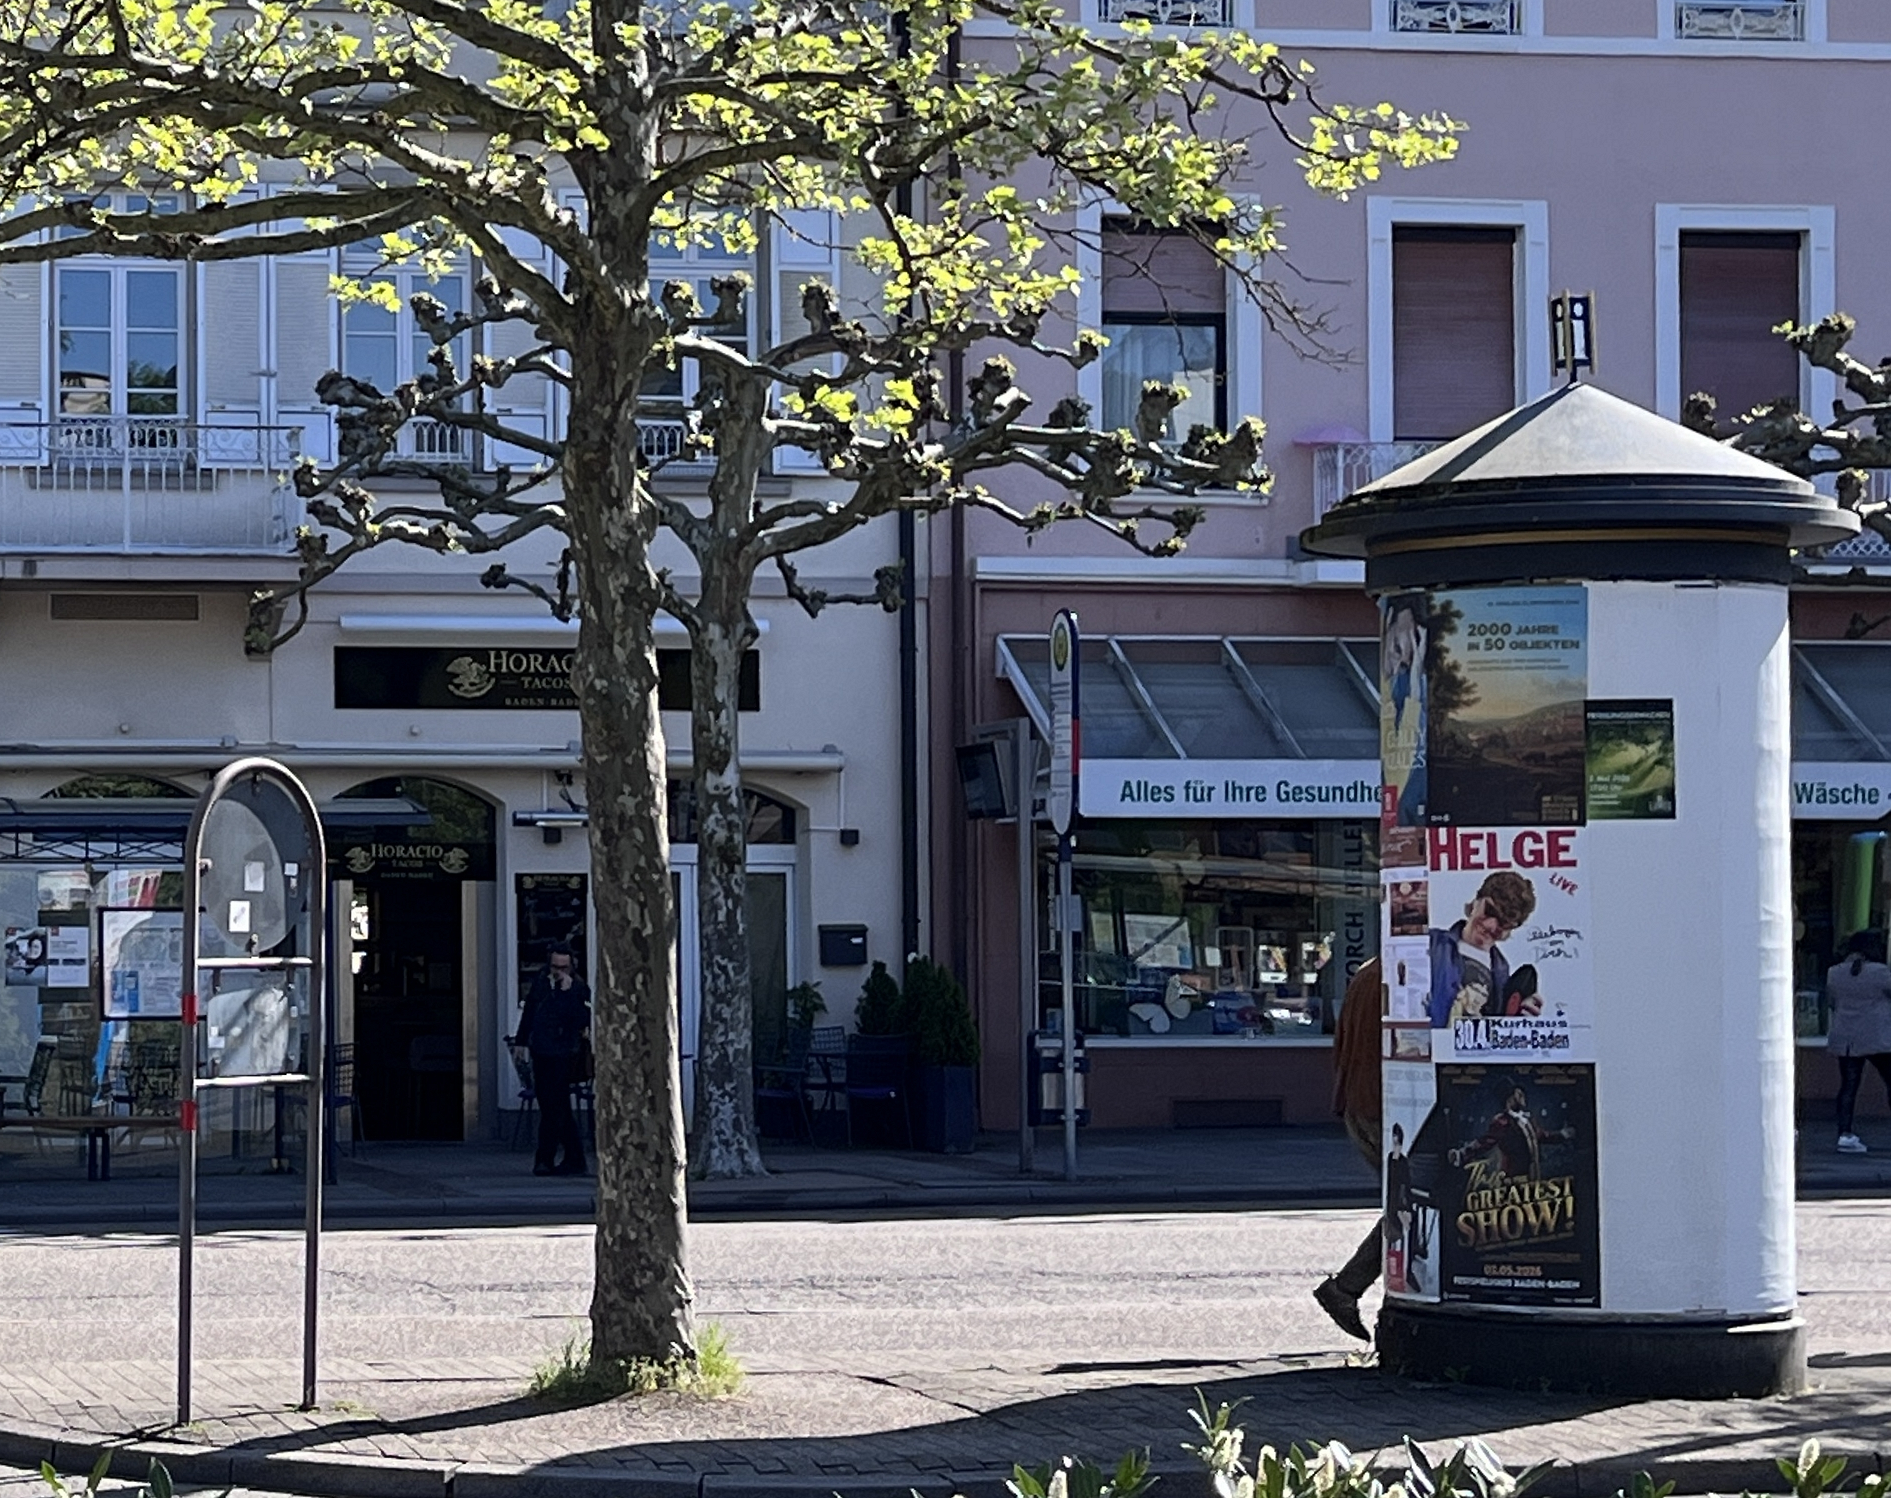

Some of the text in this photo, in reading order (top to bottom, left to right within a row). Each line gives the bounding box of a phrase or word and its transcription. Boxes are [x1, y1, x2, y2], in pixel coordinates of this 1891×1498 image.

[1467, 623, 1559, 637] 2000 JAHRE
[1484, 638, 1505, 651] 50
[1509, 640, 1580, 650] OBJEKTEN
[1120, 780, 1175, 803] Alles
[1184, 780, 1216, 803] für
[1224, 780, 1267, 803] Ihre
[1794, 782, 1880, 805] Wäsche
[371, 843, 444, 858] HORACIO
[1428, 827, 1578, 872] HELGE
[1549, 872, 1578, 896] LIVE
[1491, 1019, 1568, 1029] Kurhaus
[1491, 1030, 1569, 1049] Baden-Baden
[1467, 1176, 1574, 1211] GREATEST
[1457, 1196, 1575, 1246] SHOW!
